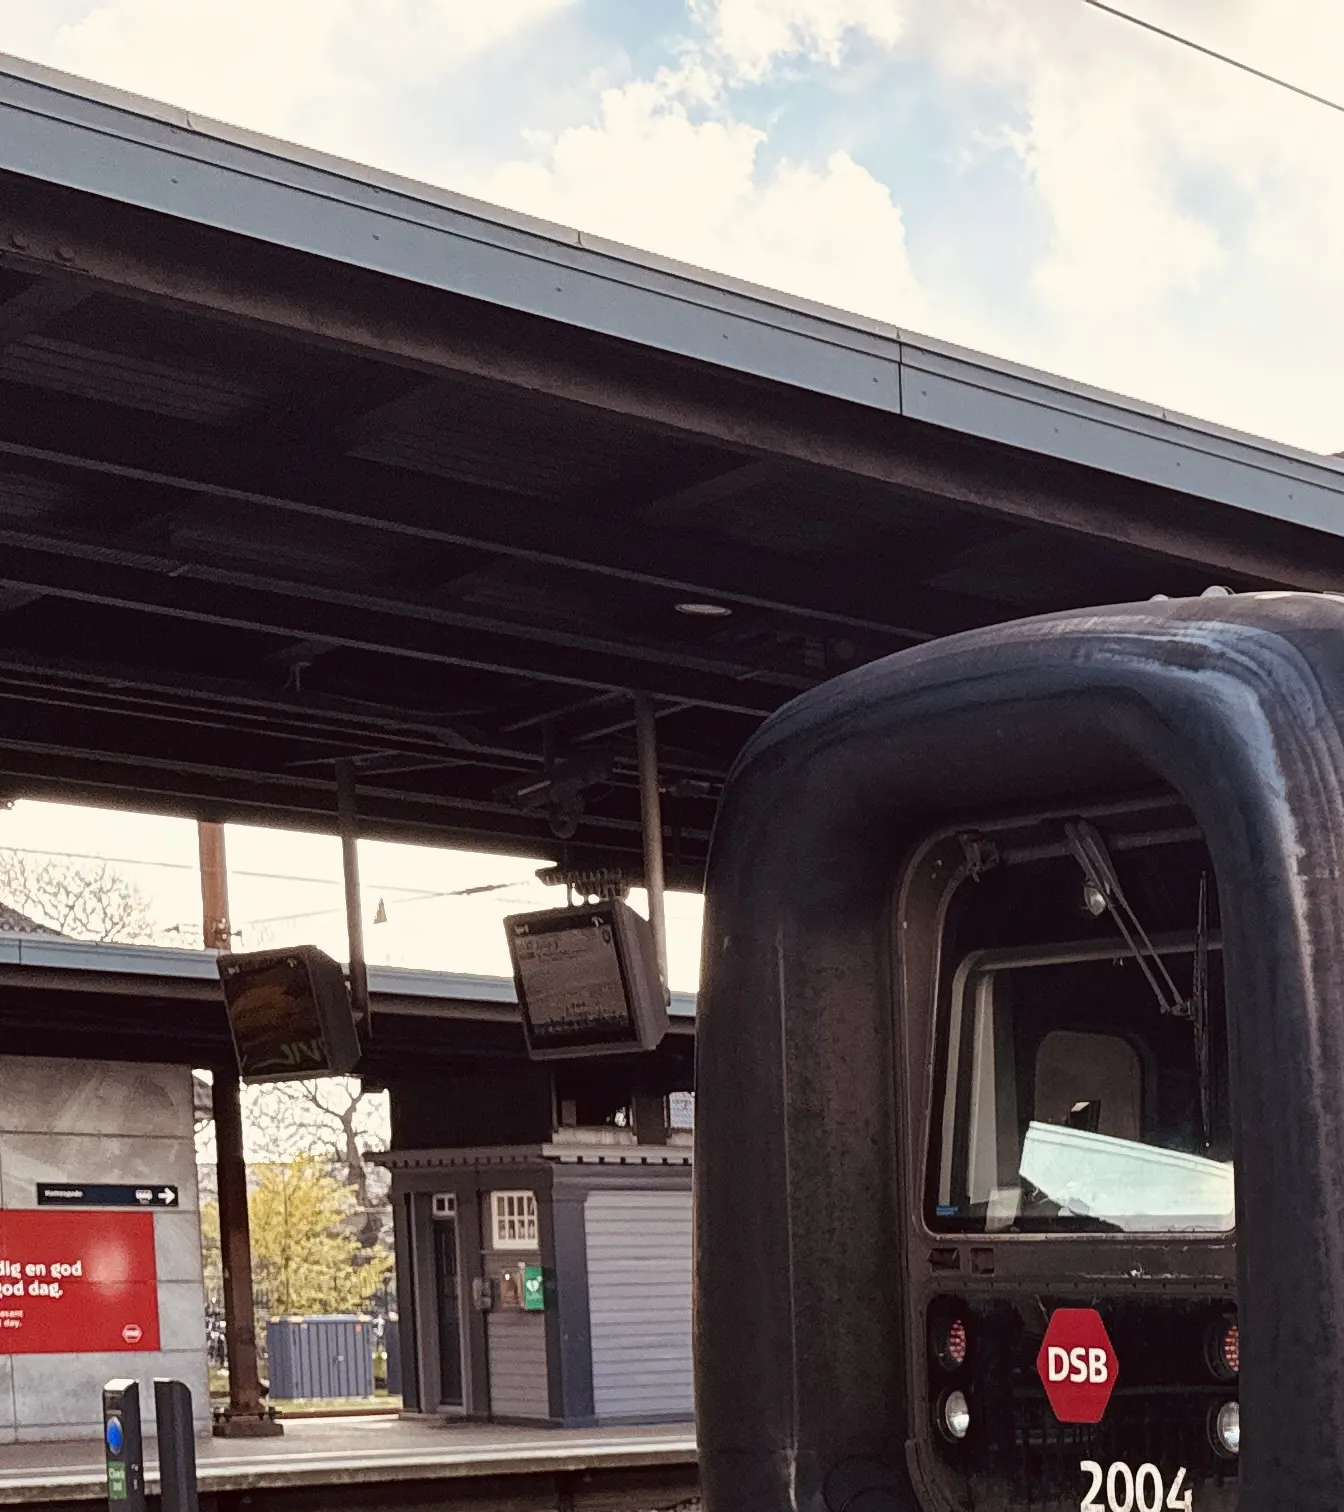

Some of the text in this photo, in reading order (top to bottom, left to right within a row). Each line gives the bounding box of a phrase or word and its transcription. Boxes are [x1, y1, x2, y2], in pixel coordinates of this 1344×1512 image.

[25, 1263, 47, 1277] en
[50, 1260, 83, 1279] god
[0, 1279, 64, 1299] od dag.
[1047, 1346, 1108, 1384] DSB
